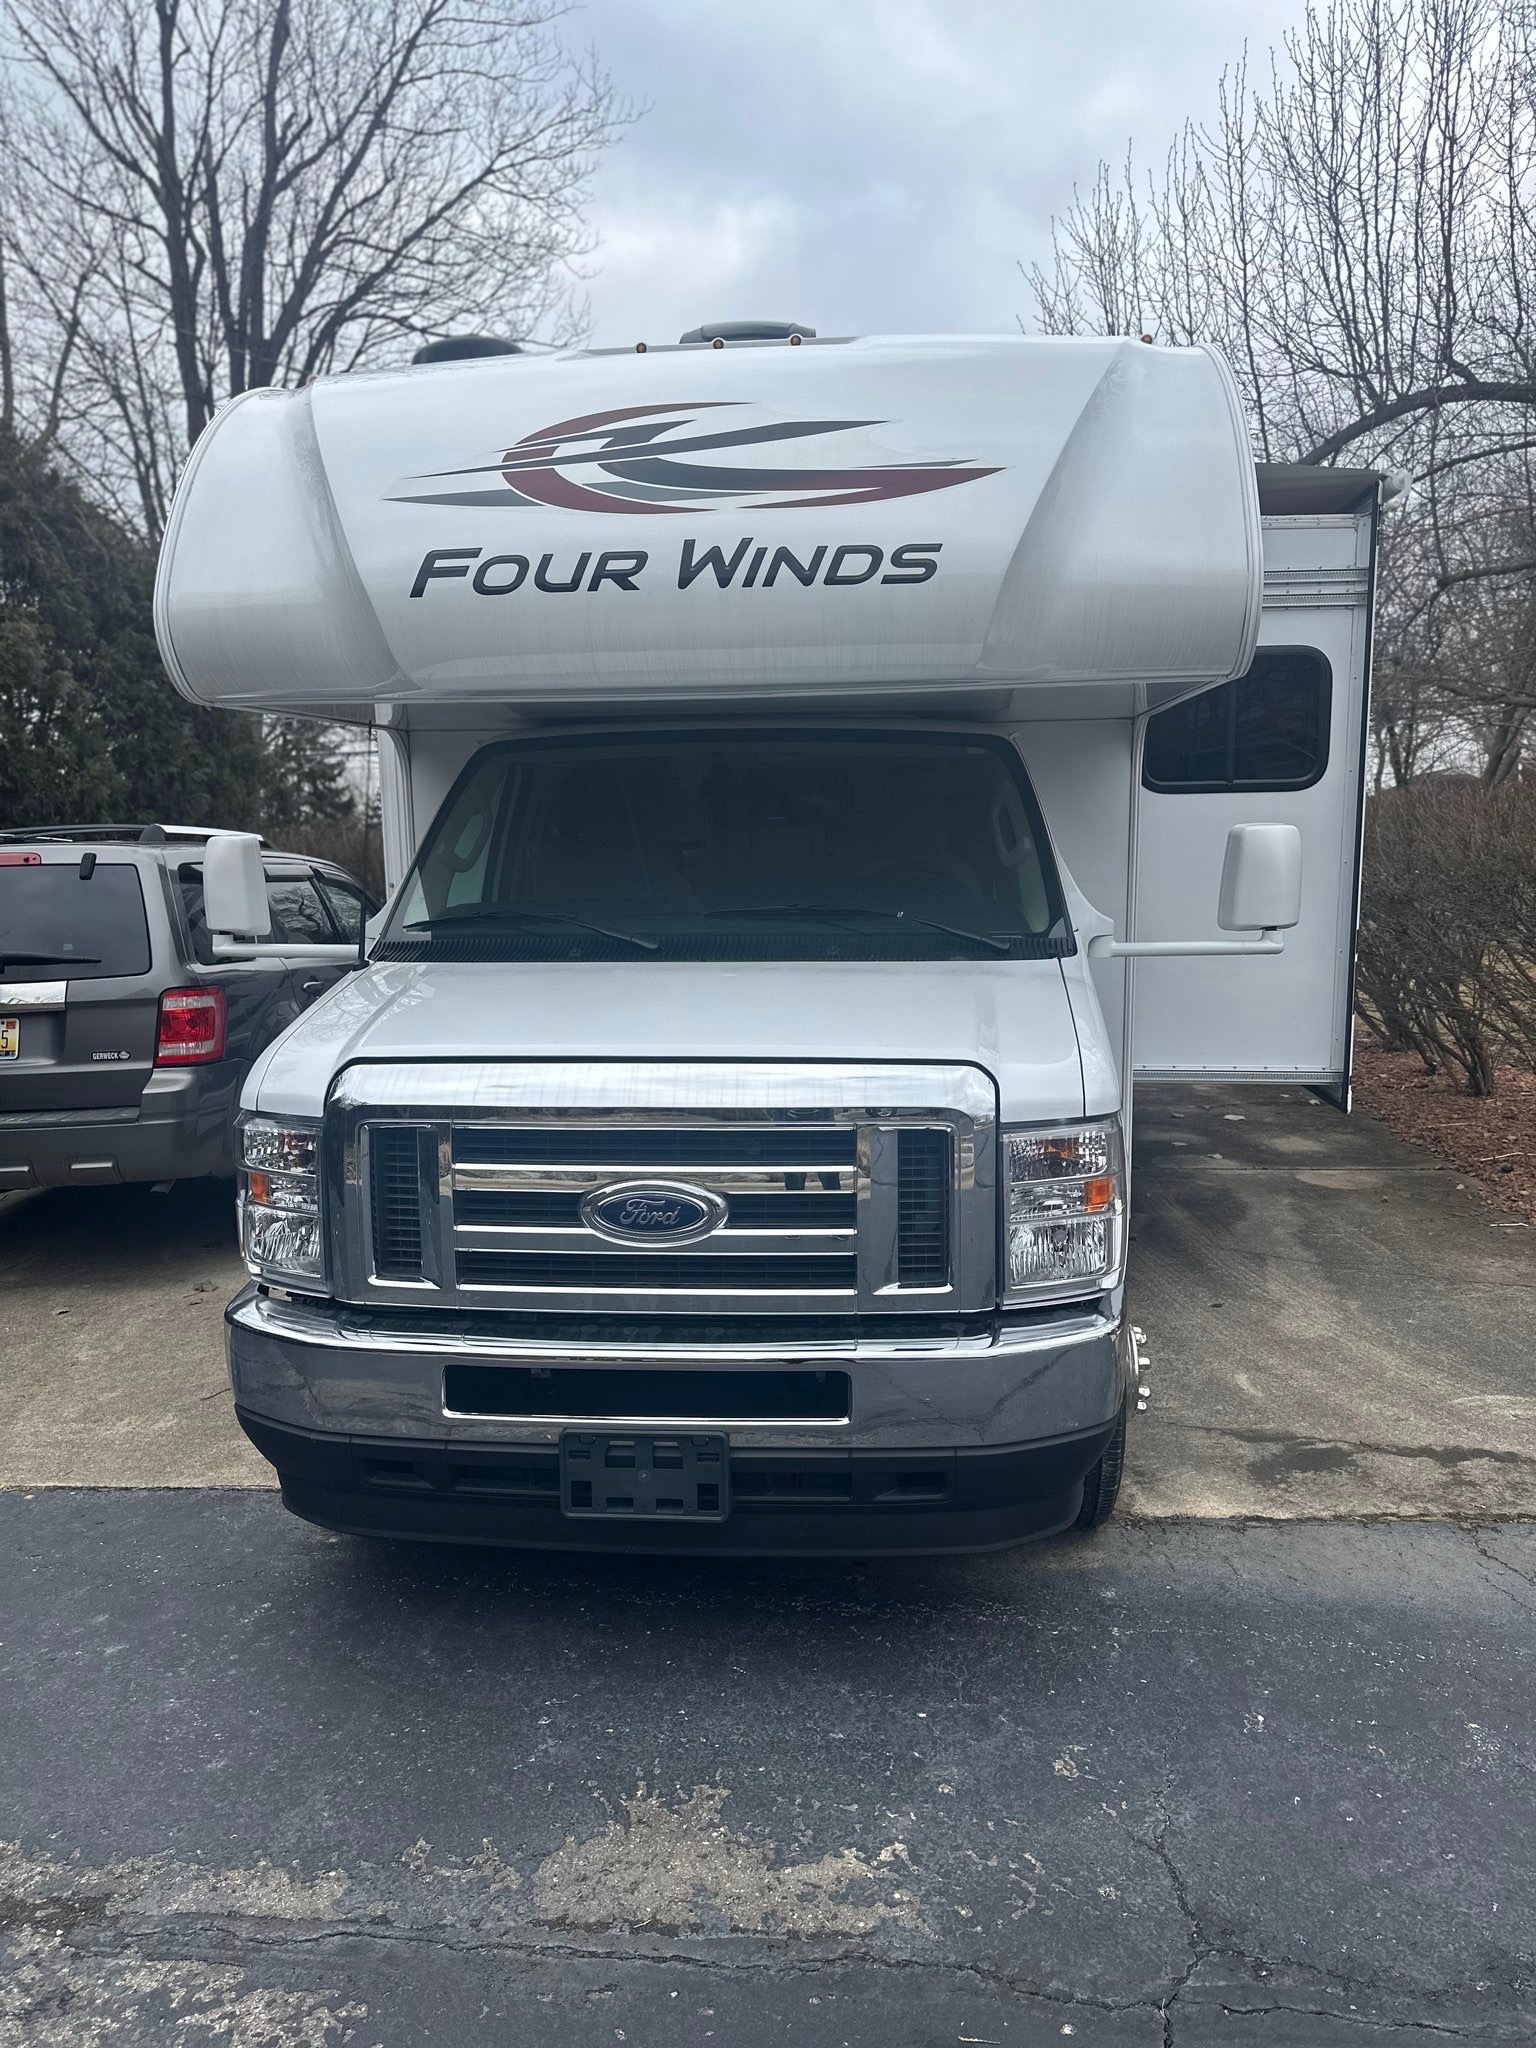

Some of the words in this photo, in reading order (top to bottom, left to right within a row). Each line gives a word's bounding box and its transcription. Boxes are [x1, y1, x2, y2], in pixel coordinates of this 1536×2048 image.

[0, 1029, 9, 1049] 5
[92, 1052, 119, 1060] GERWECK
[619, 1198, 682, 1226] Ford
